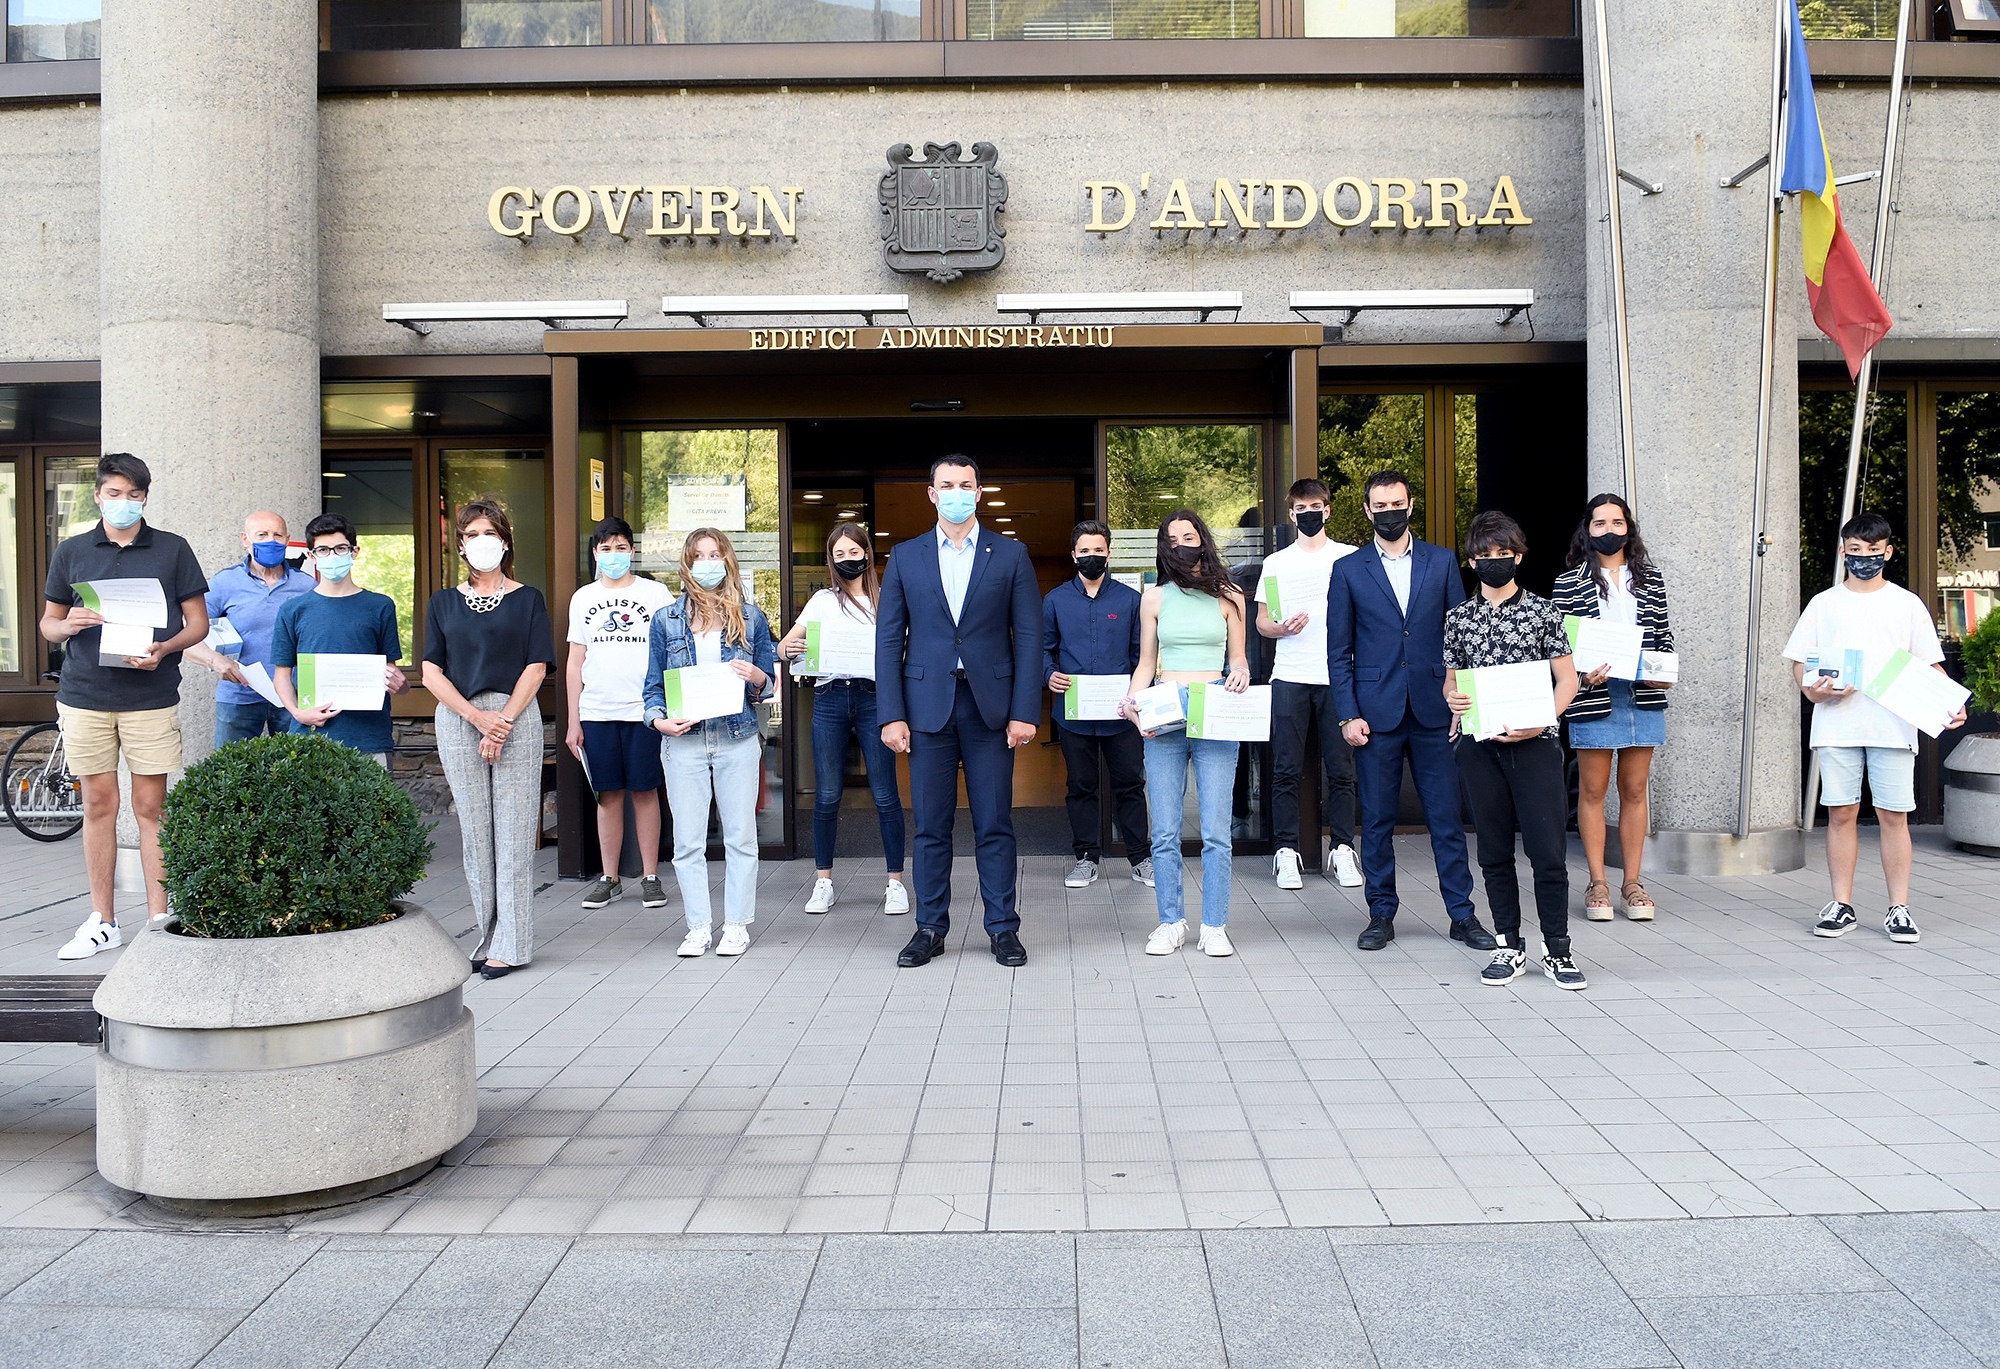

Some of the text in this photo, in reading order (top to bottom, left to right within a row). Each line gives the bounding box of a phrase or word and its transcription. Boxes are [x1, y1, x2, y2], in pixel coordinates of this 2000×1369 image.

[488, 172, 1533, 237] GOVERN D'ANDORRA
[749, 325, 1115, 351] EDIFICI ADMINISTRATIU
[584, 598, 651, 625] HOLLISTER
